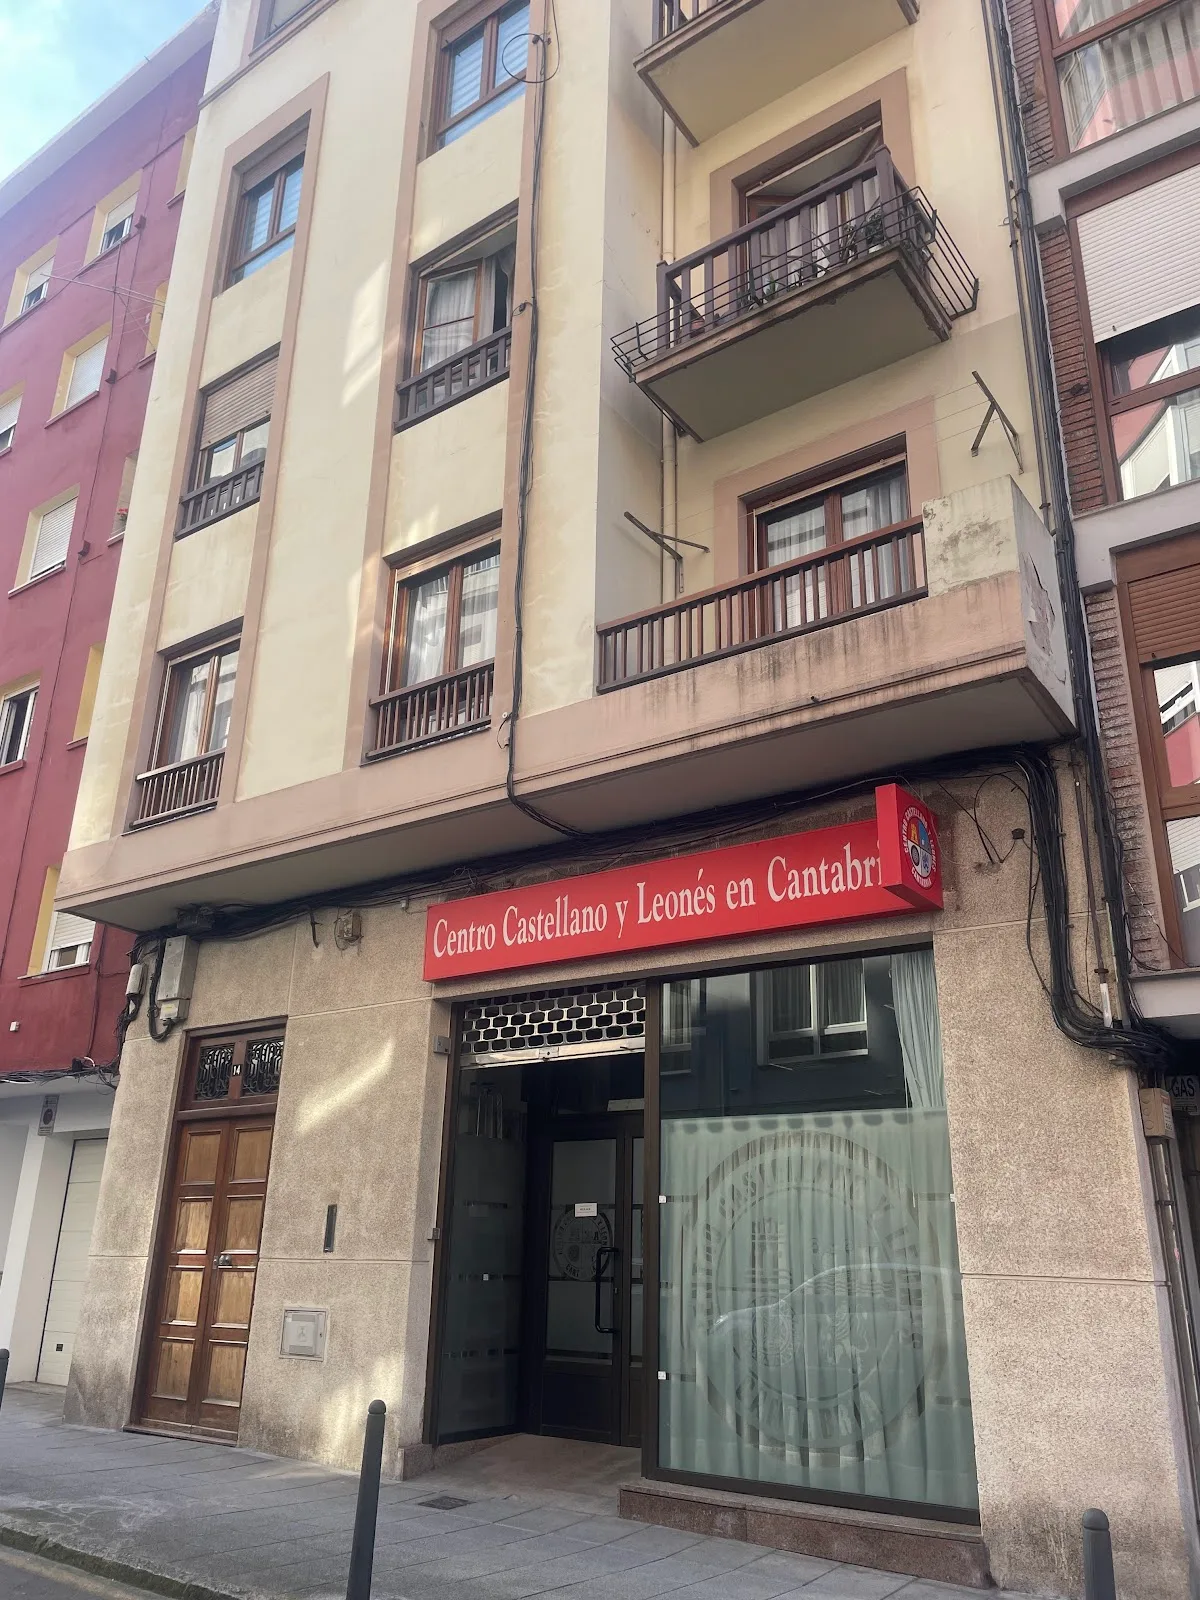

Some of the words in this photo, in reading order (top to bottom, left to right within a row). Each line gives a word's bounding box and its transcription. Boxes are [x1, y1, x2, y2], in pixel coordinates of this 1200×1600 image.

[433, 918, 496, 958] Centro
[502, 894, 608, 947] Castellano
[615, 900, 629, 939] y
[636, 868, 716, 924] Leonés
[726, 877, 756, 910] en
[767, 839, 882, 902] Cantabri
[233, 1064, 241, 1076] 14
[1171, 1077, 1195, 1098] GAS
